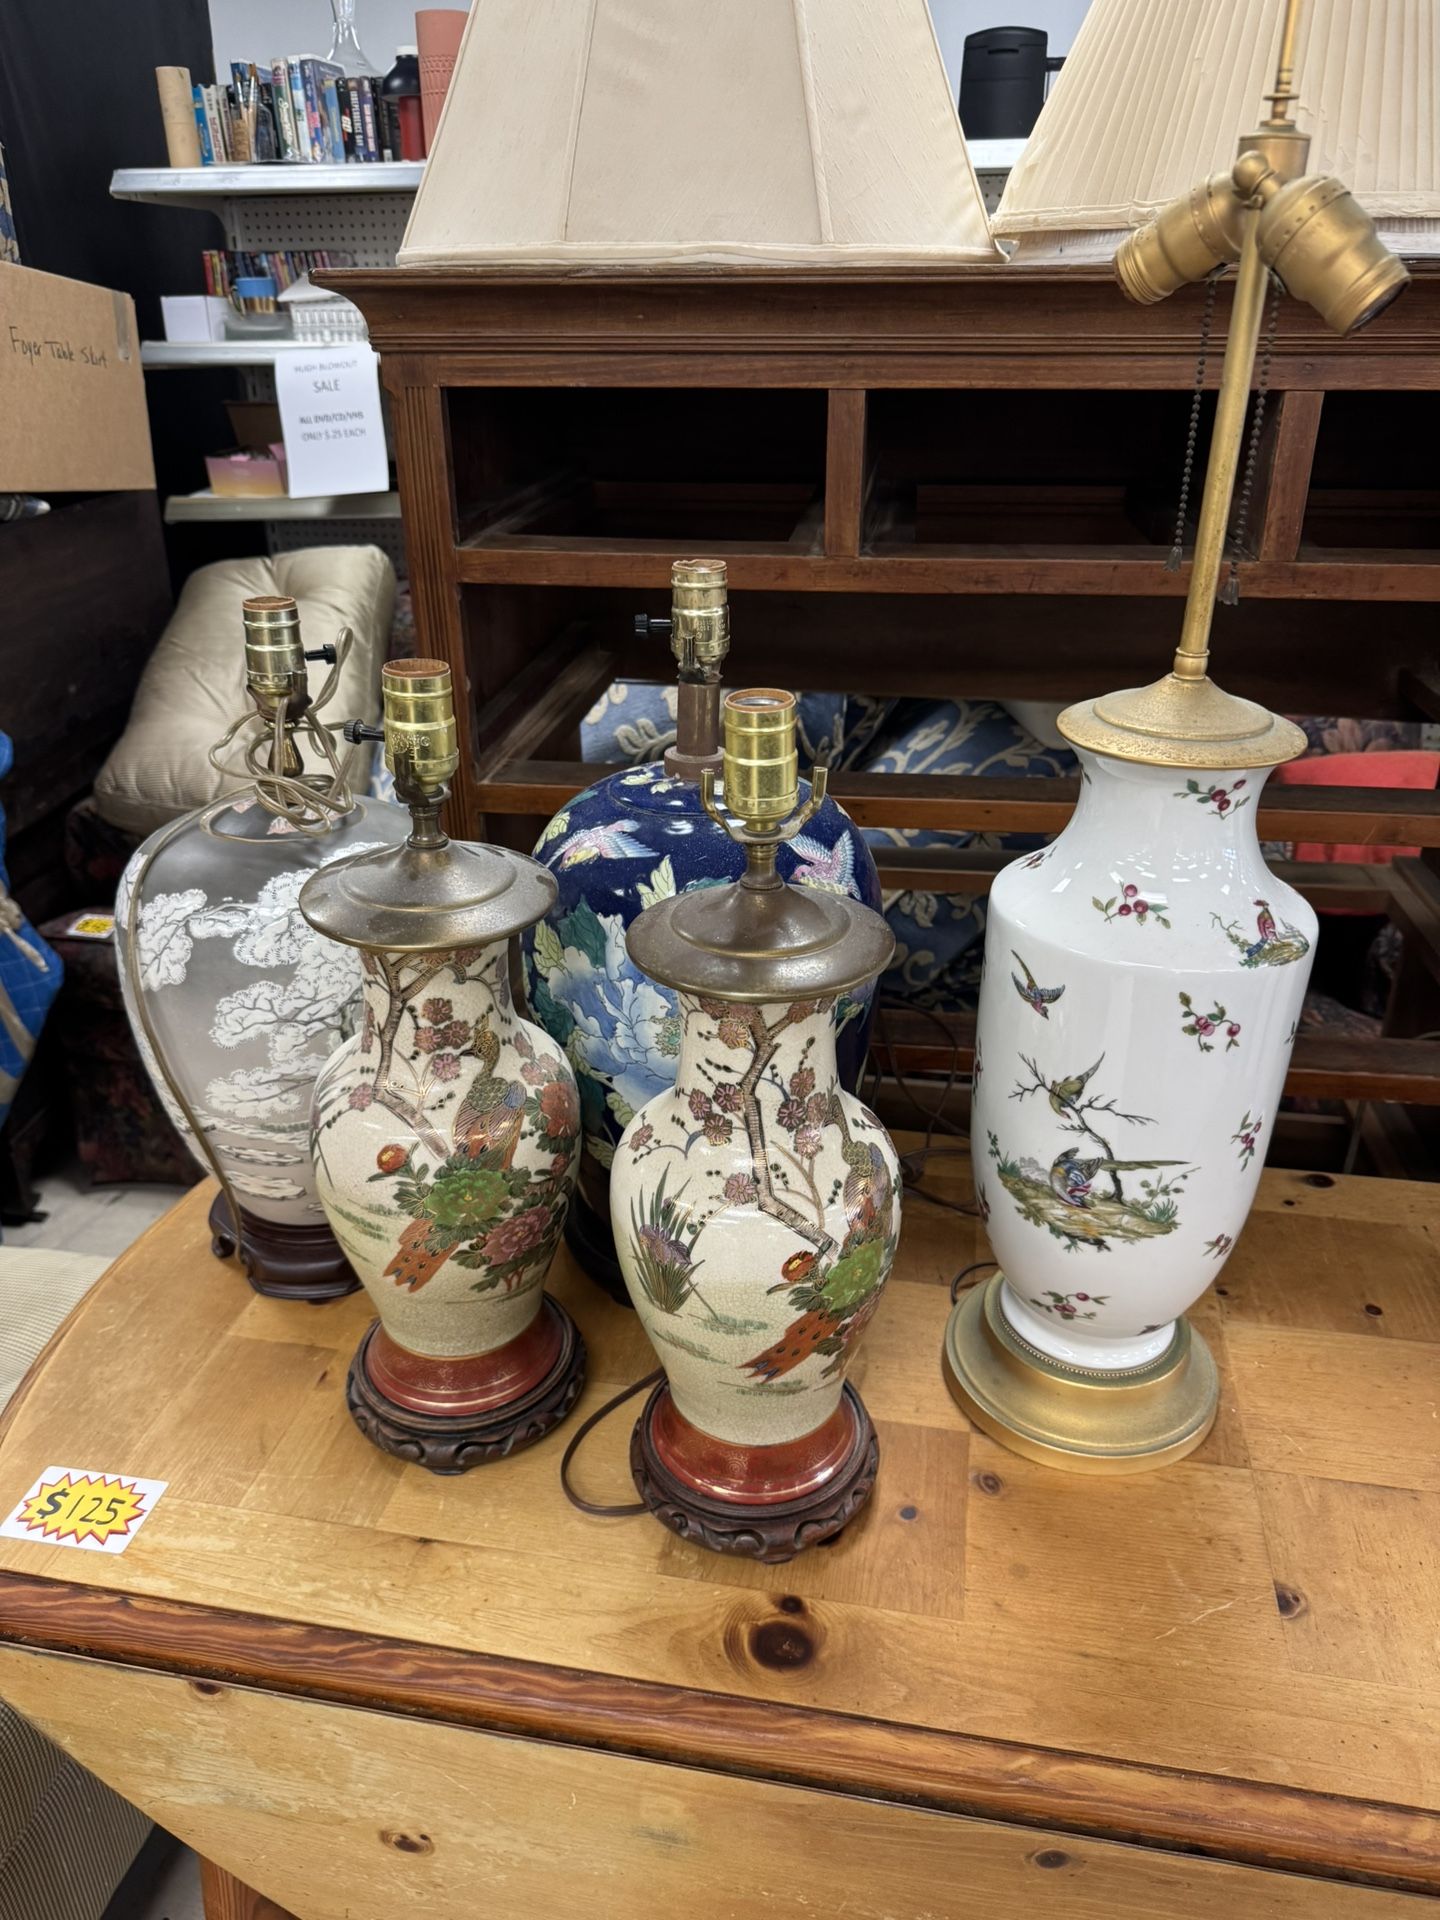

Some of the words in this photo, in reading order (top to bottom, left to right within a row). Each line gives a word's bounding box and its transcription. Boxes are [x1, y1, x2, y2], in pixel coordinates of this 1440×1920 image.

[313, 379, 341, 393] SALE
[301, 431, 323, 442] ONLY
[343, 427, 367, 438] EACH
[36, 1487, 126, 1525] $125
